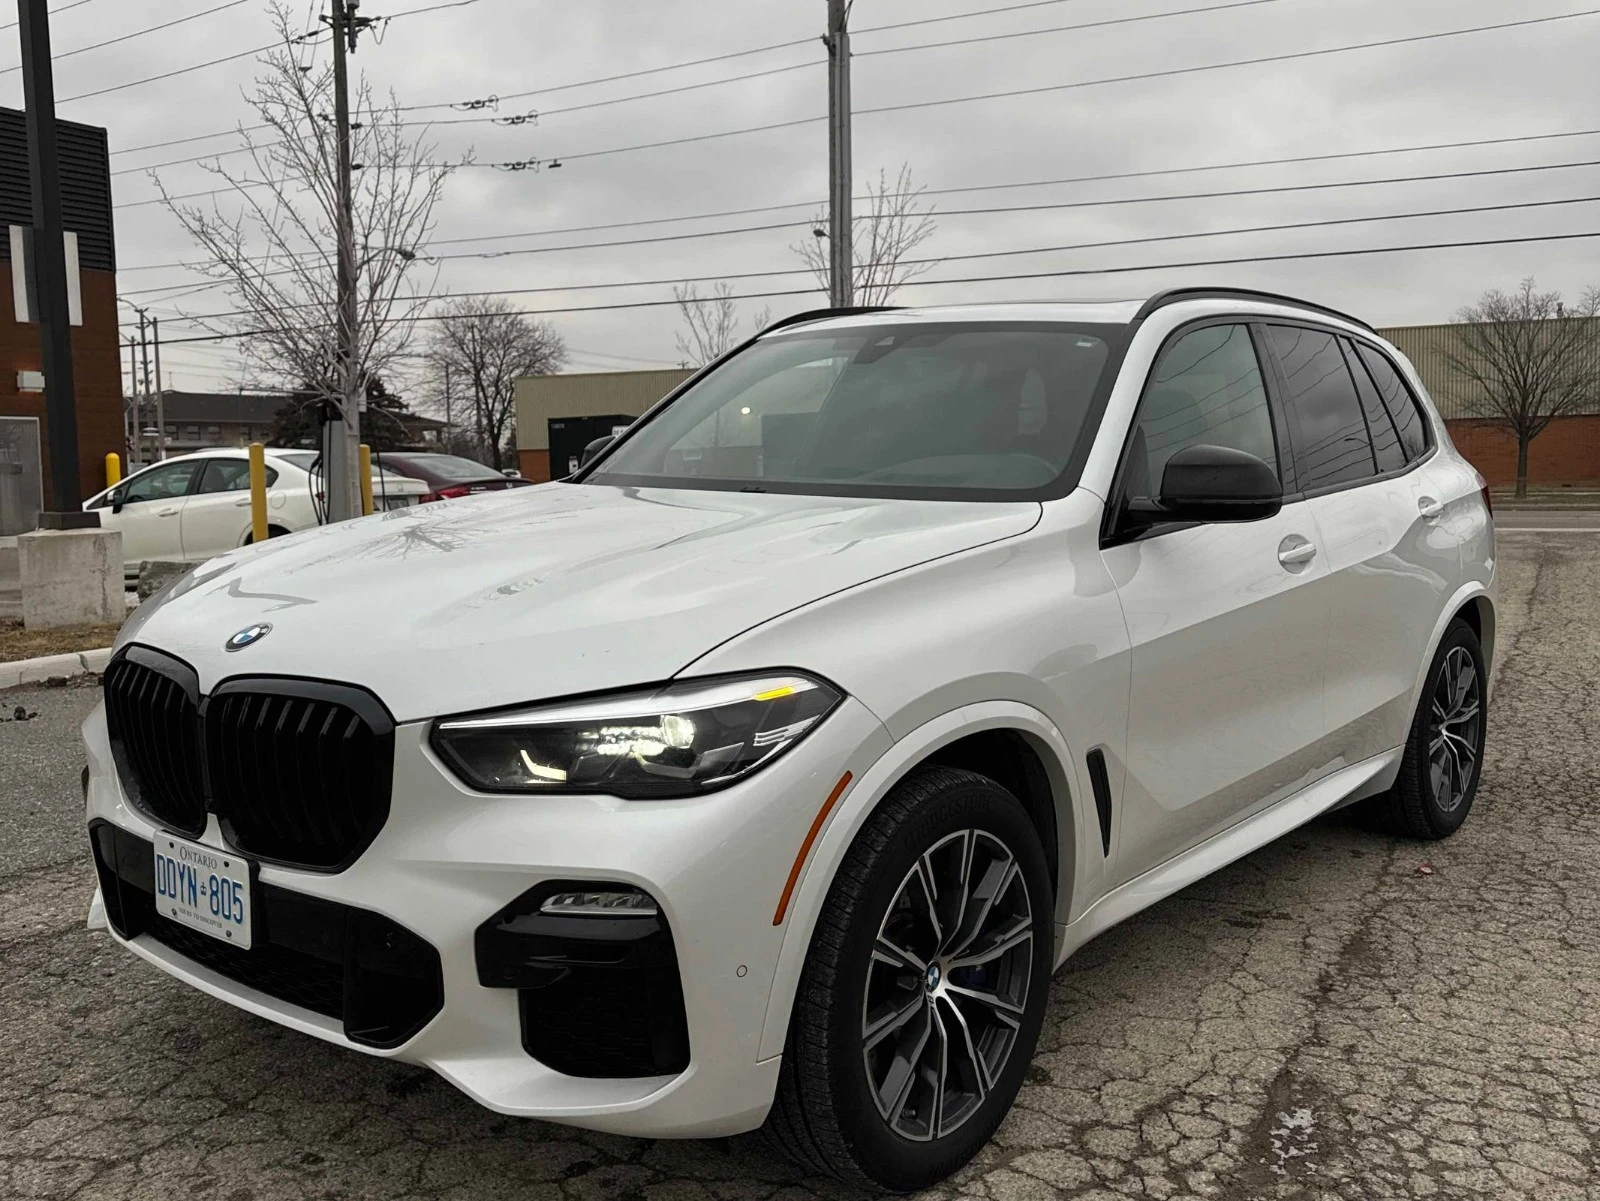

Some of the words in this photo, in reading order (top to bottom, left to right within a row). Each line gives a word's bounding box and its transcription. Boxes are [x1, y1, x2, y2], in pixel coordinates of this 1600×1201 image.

[180, 846, 217, 869] ONTARIO
[156, 853, 197, 908] DDYN
[209, 874, 243, 924] 805
